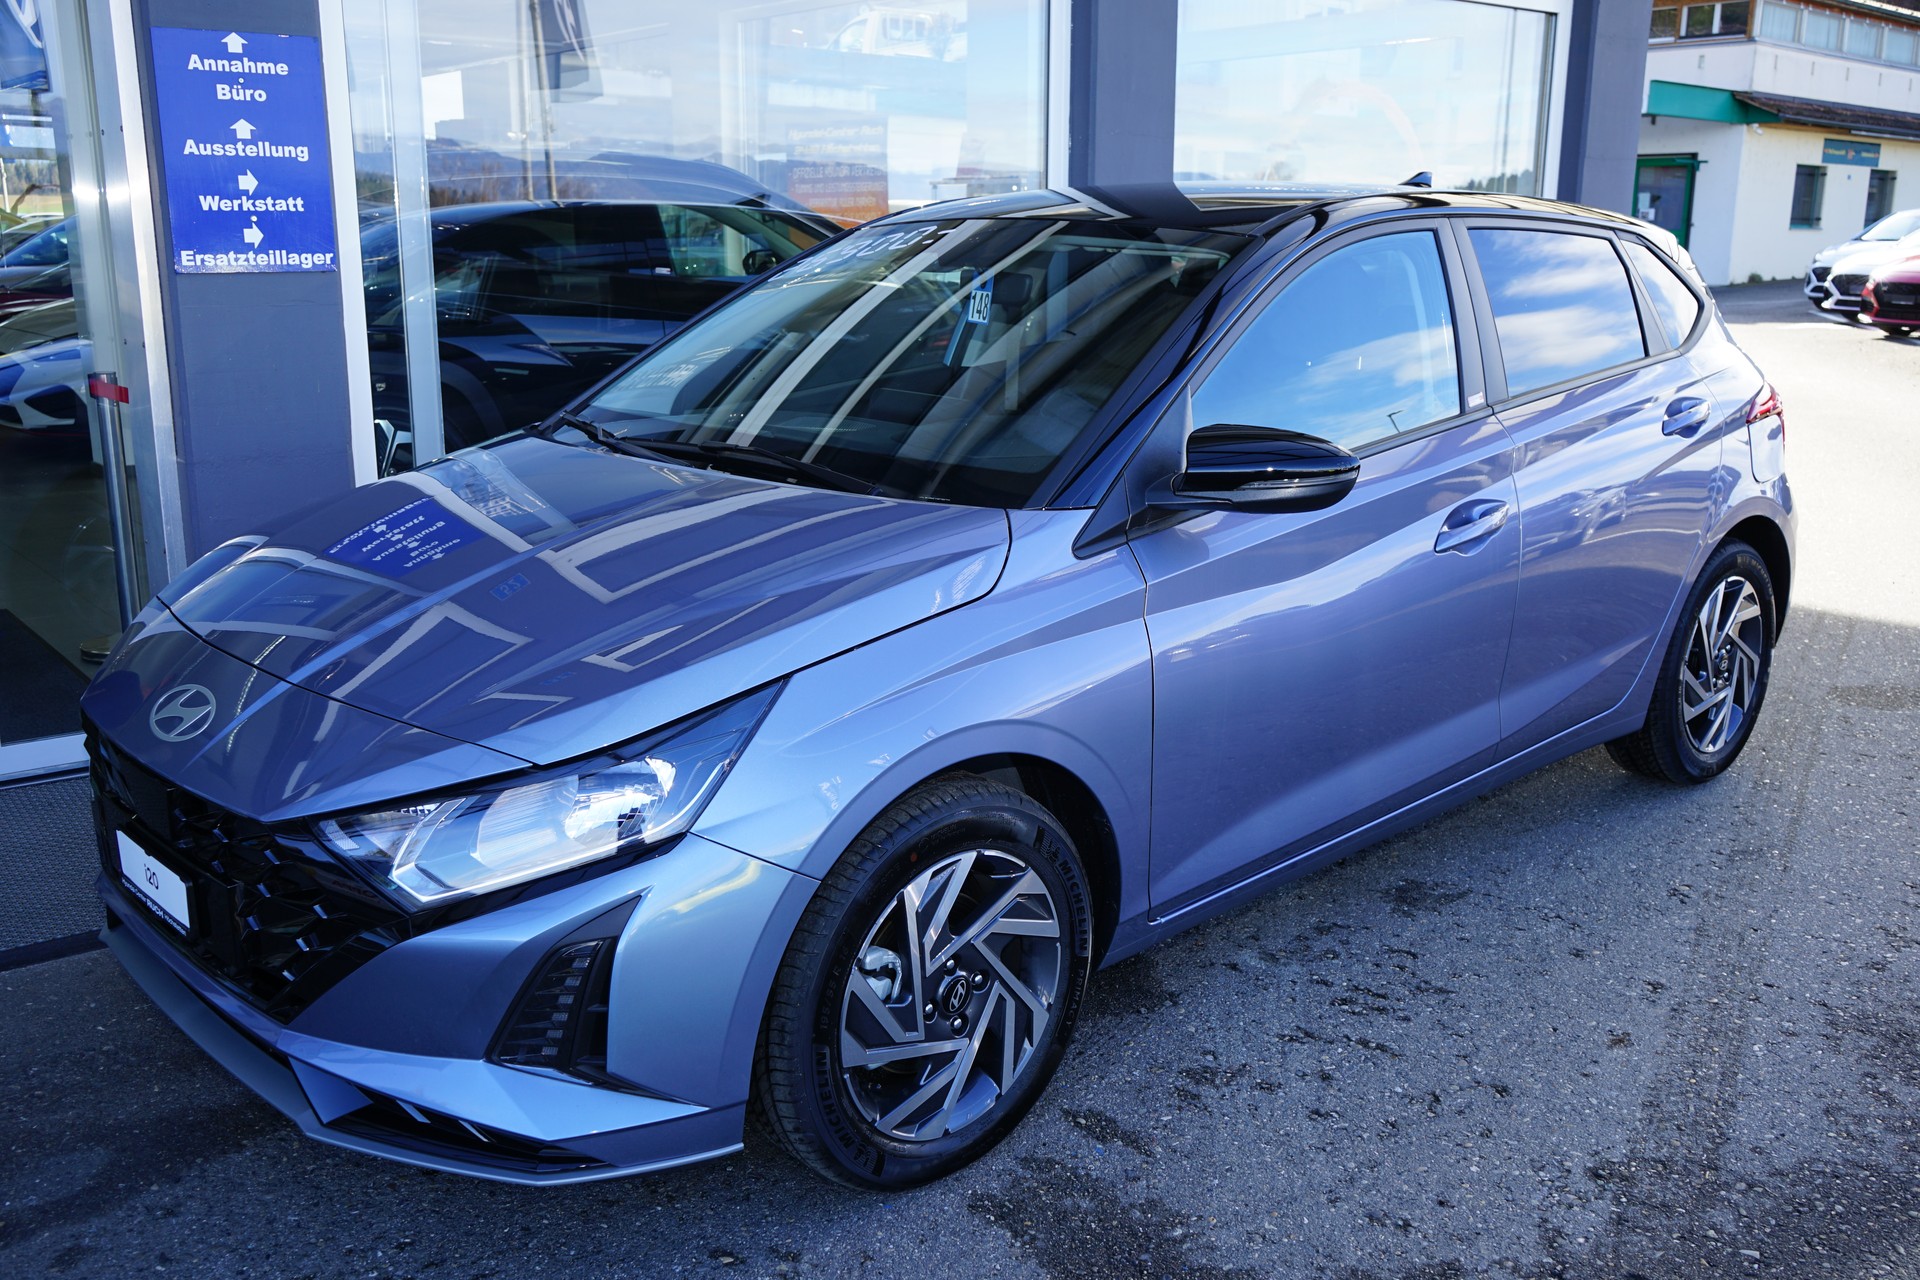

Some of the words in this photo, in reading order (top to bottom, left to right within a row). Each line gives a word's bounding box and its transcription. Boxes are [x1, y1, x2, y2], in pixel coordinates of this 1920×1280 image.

[187, 54, 289, 76] Annahme
[216, 83, 267, 102] Büro
[183, 139, 309, 162] Ausstellung
[199, 195, 305, 212] Werkstatt
[180, 250, 334, 269] Ersatzteillager
[971, 291, 990, 321] 148
[143, 863, 160, 891] i20
[1057, 858, 1088, 951] MICHELIN
[815, 1051, 856, 1150] MICHELIN
